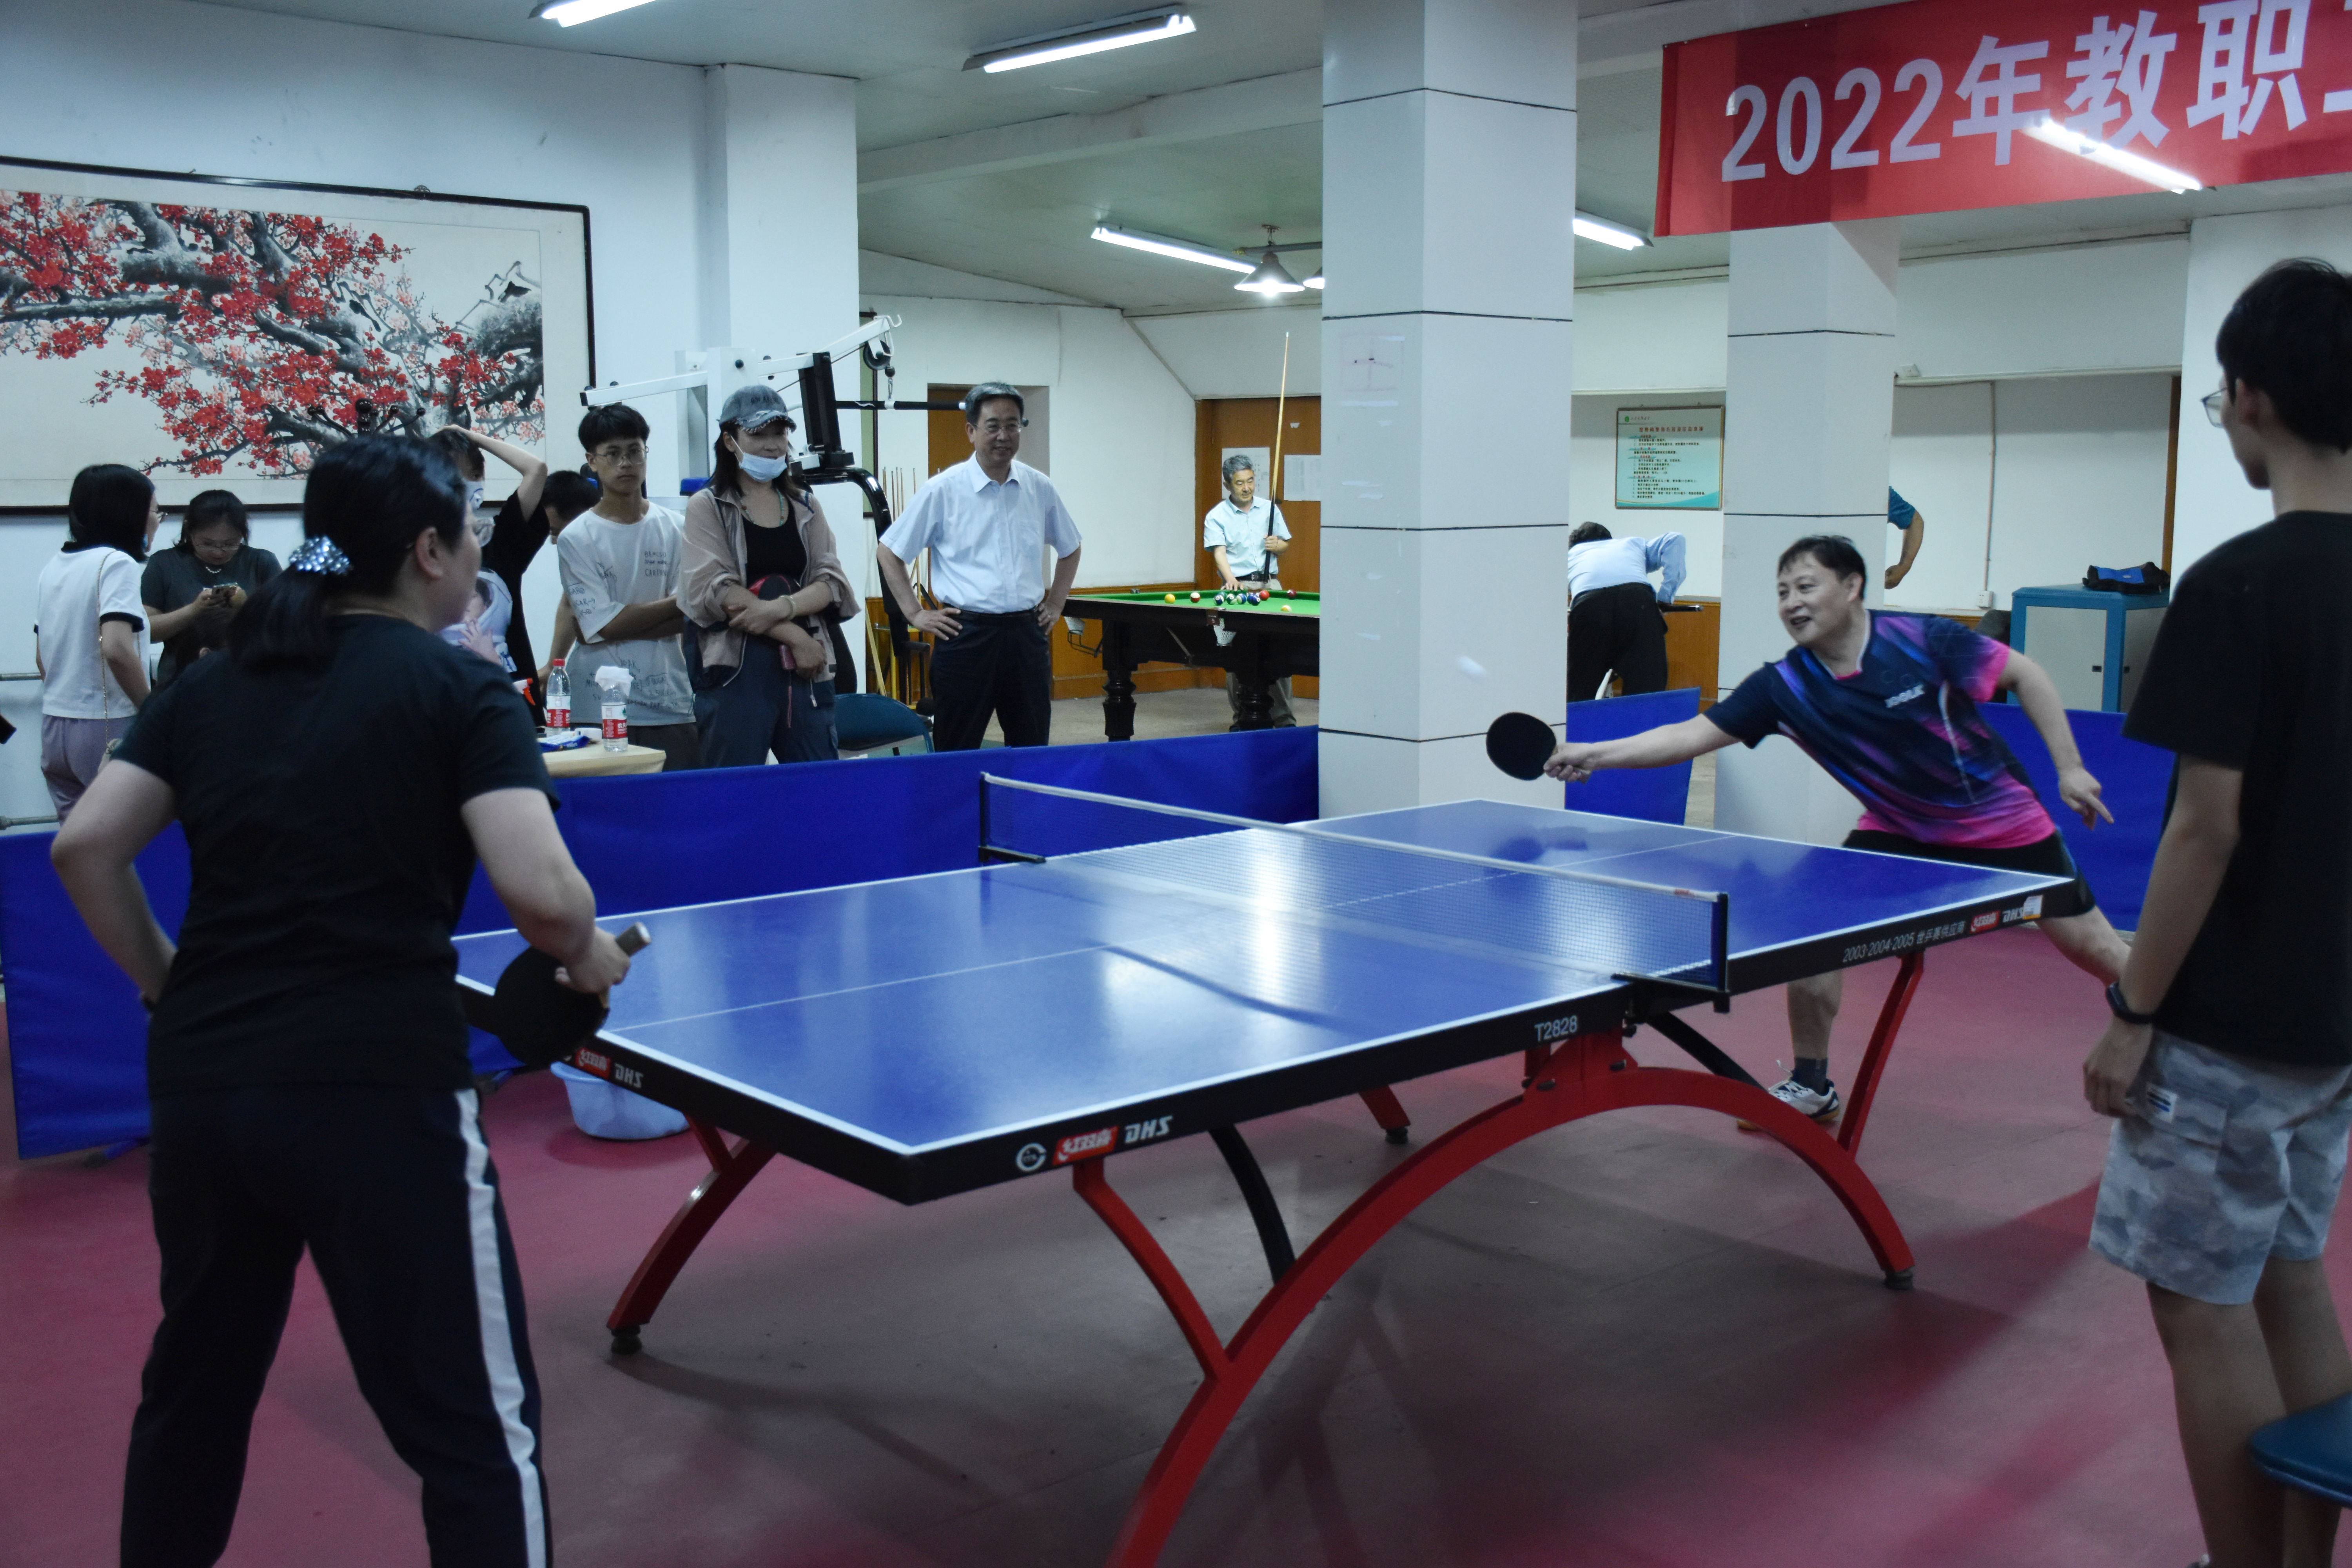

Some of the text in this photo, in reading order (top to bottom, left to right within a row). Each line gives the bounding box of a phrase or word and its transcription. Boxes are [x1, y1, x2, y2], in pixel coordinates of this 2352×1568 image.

[1534, 1014, 1577, 1041] T2828
[615, 1063, 644, 1088] DHS
[1124, 1115, 1173, 1143] DHS
